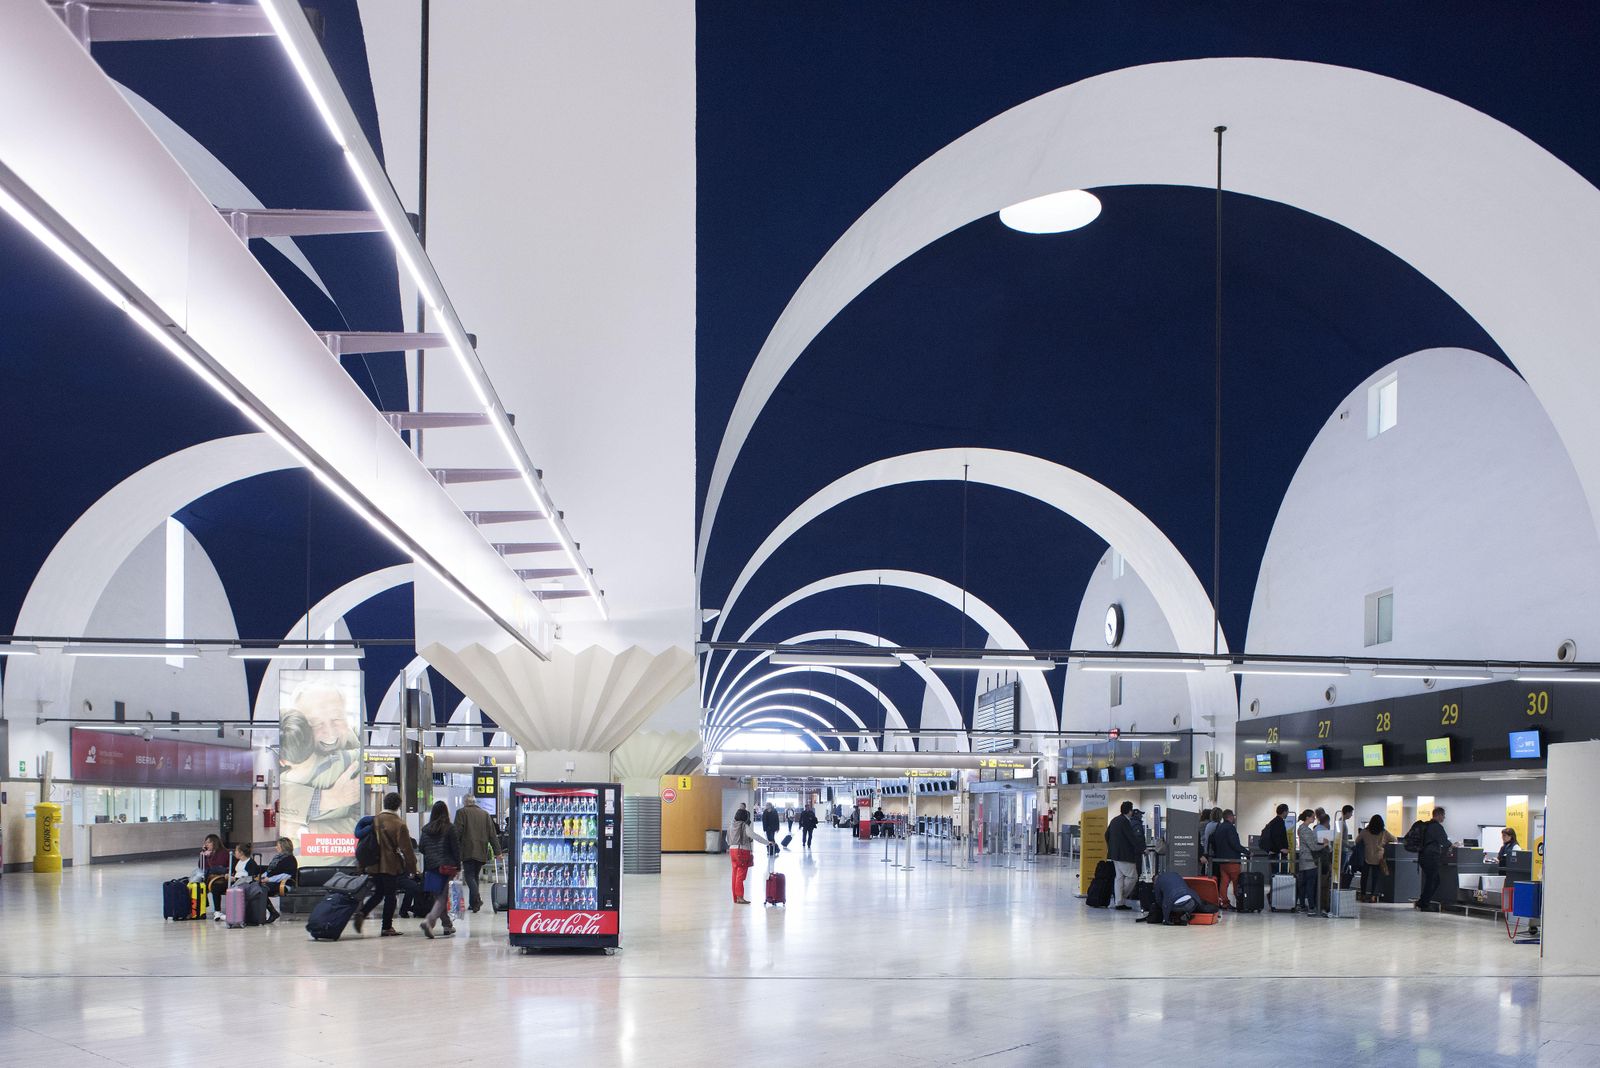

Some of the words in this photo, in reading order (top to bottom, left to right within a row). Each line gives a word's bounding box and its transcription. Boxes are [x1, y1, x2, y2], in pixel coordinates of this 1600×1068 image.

[1526, 691, 1549, 716] 30
[1376, 712, 1392, 732] 28
[1441, 703, 1459, 725] 29
[1267, 727, 1277, 744] 26
[1318, 720, 1331, 738] 27
[136, 755, 156, 766] IBERIA
[1085, 793, 1106, 801] vueling
[1171, 792, 1198, 803] vueling
[1508, 809, 1524, 819] vueling
[43, 816, 51, 852] CORREOS
[315, 837, 356, 846] PUBLICIDAD
[306, 845, 321, 854] QUE
[321, 845, 330, 853] TE
[329, 845, 356, 854] ATRAPA
[521, 911, 606, 935] Coca-Cola
